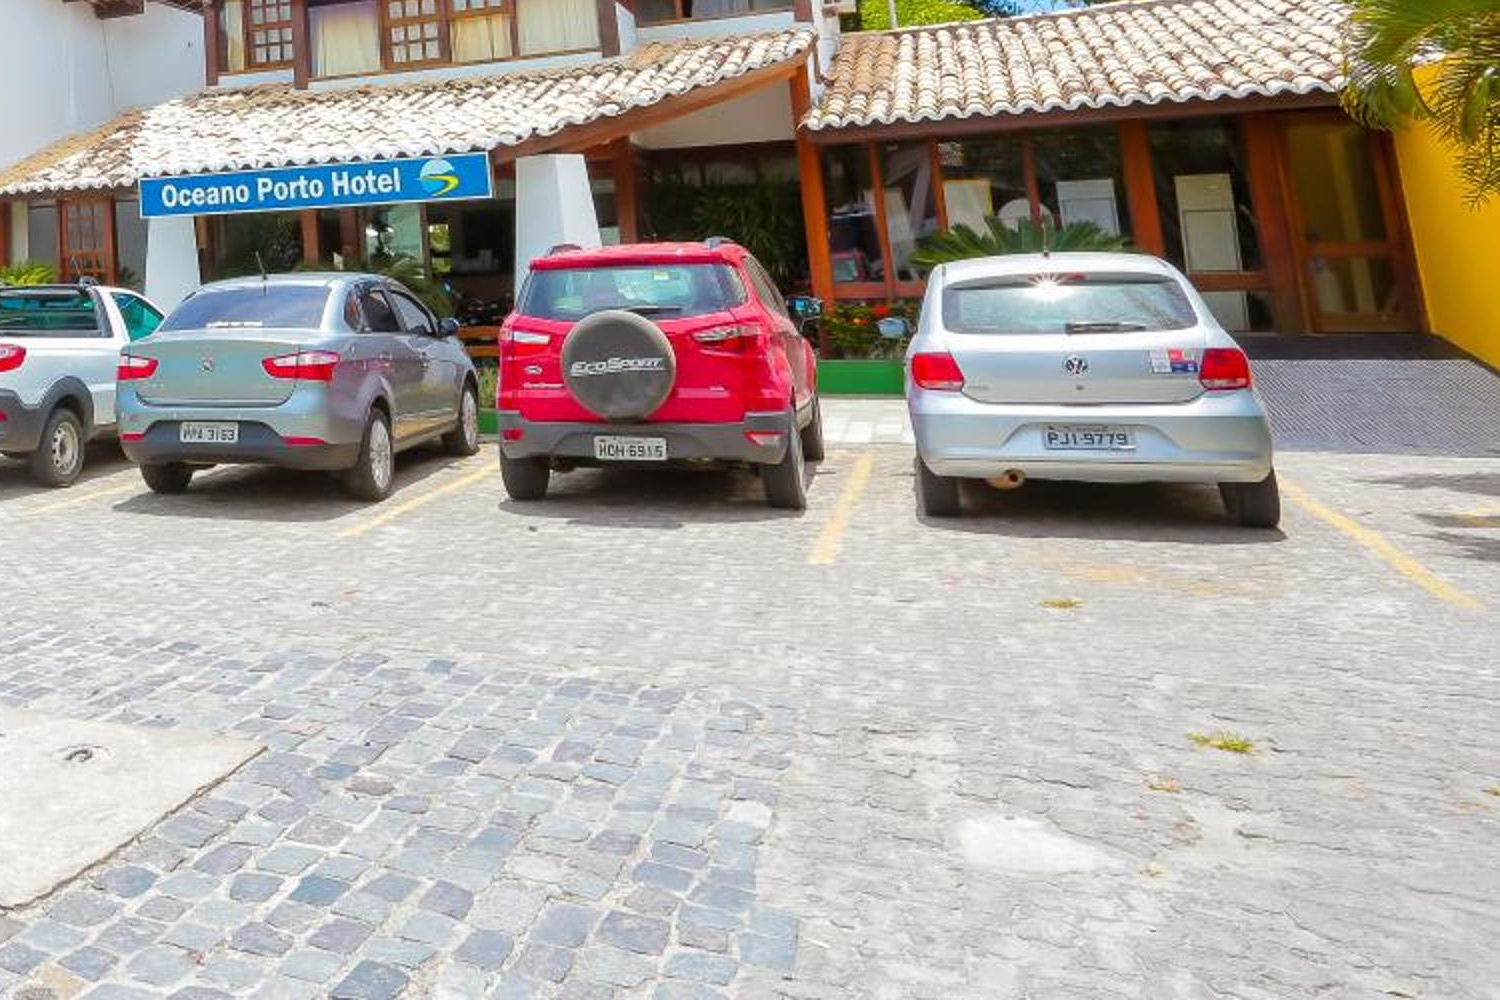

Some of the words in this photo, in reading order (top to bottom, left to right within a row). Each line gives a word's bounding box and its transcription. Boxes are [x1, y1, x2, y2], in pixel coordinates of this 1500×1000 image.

[161, 184, 250, 208] Oceano
[257, 177, 324, 201] Porto
[331, 167, 401, 197] Hotel
